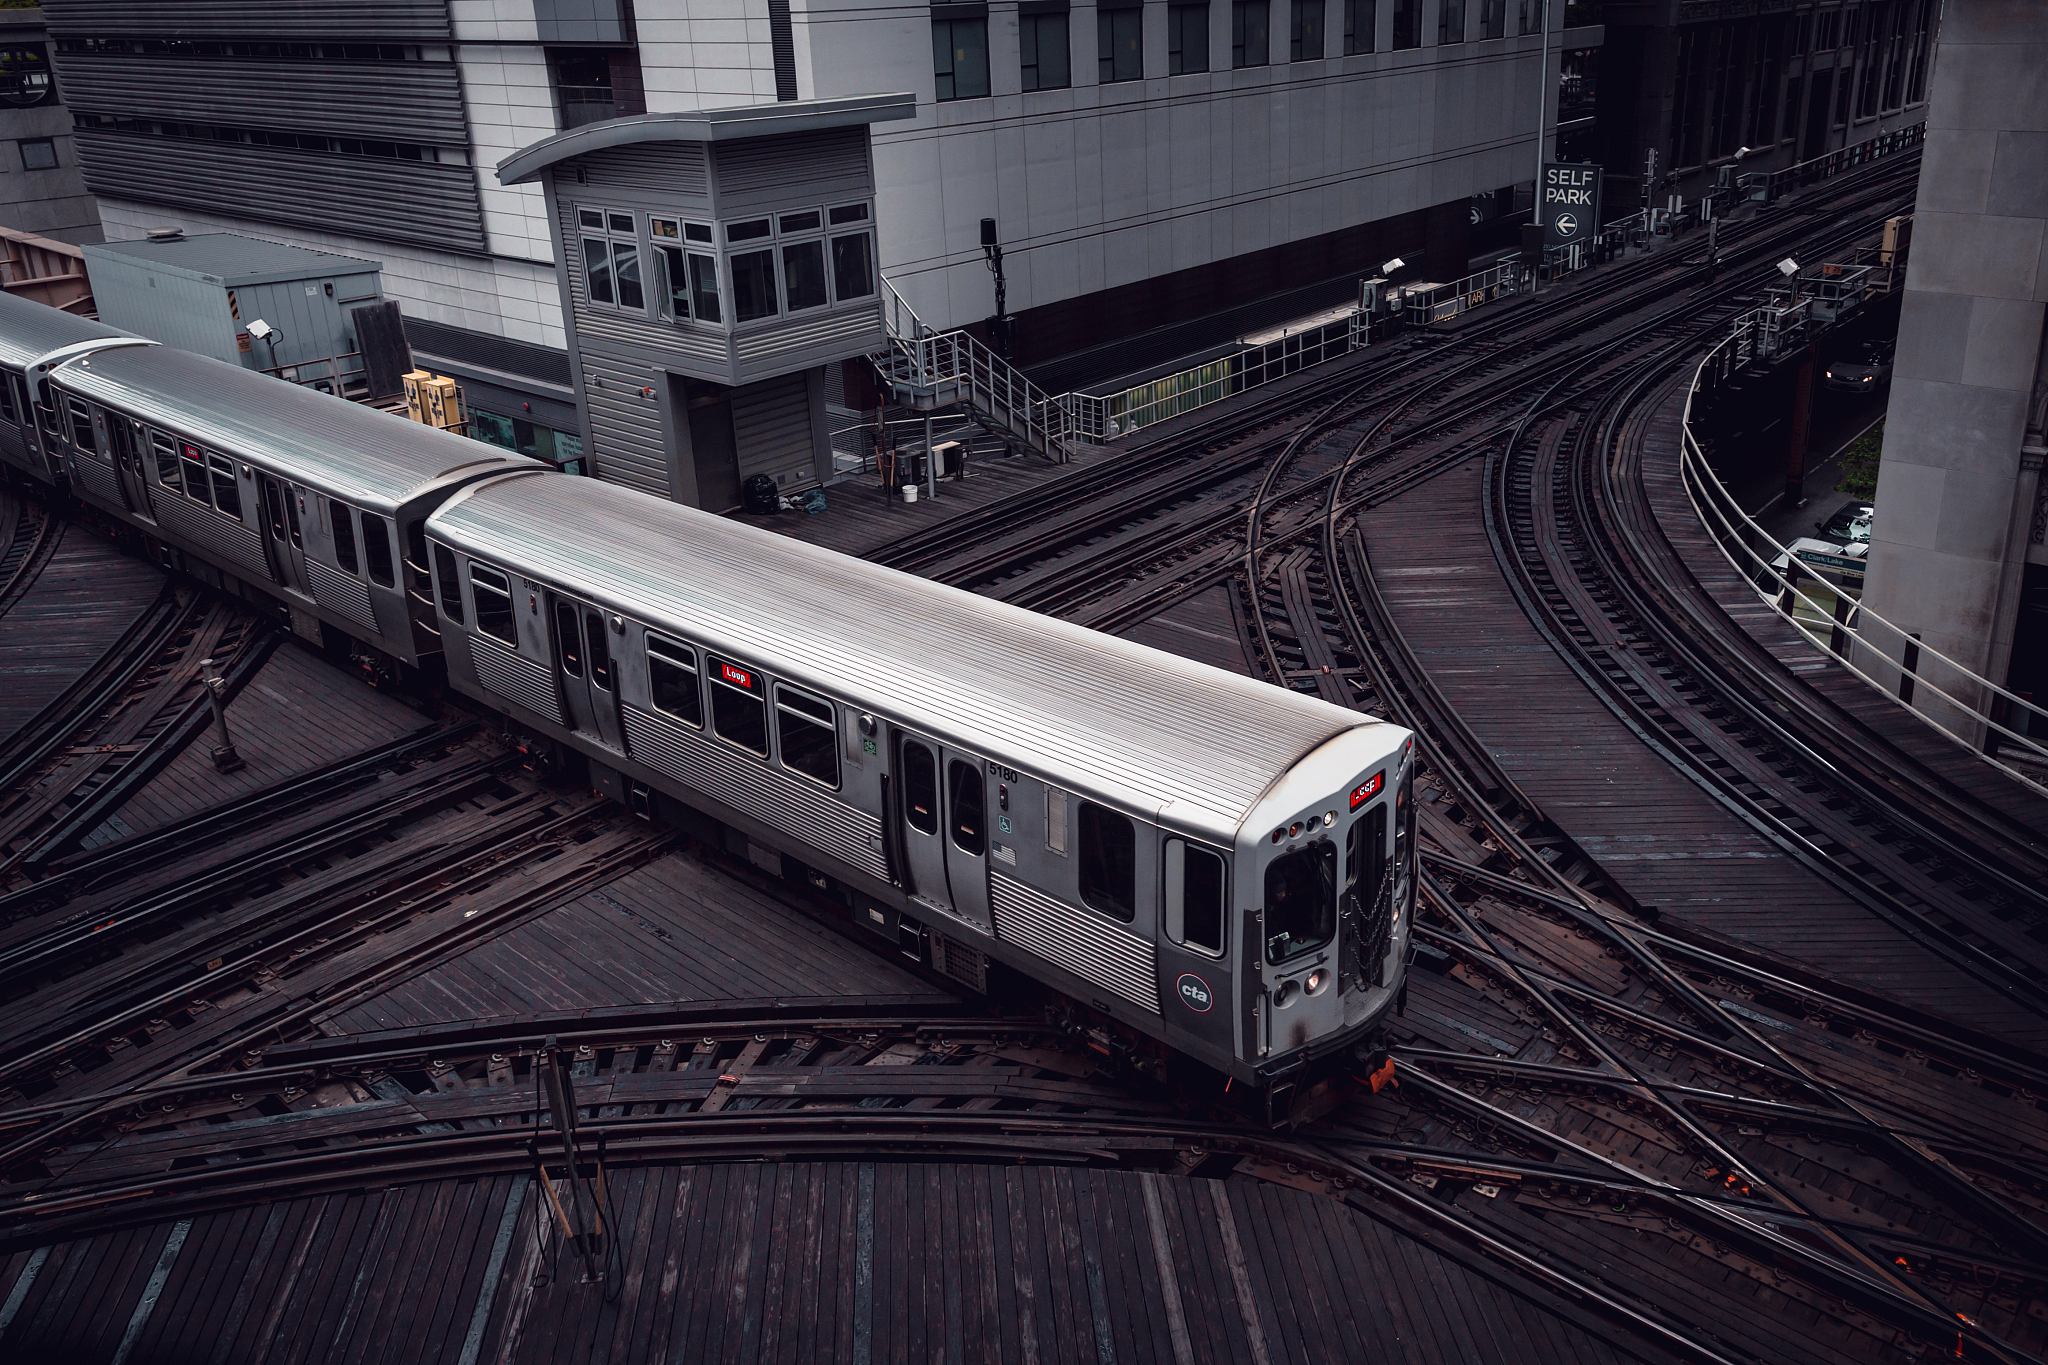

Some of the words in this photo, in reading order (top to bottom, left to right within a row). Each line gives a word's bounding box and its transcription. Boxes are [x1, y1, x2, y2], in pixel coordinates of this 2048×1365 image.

[1547, 169, 1593, 186] SELF
[1546, 187, 1592, 205] PARK
[523, 579, 540, 593] 5180
[727, 666, 745, 684] Loop
[990, 762, 1018, 784] 5180
[1182, 985, 1208, 1003] cta
